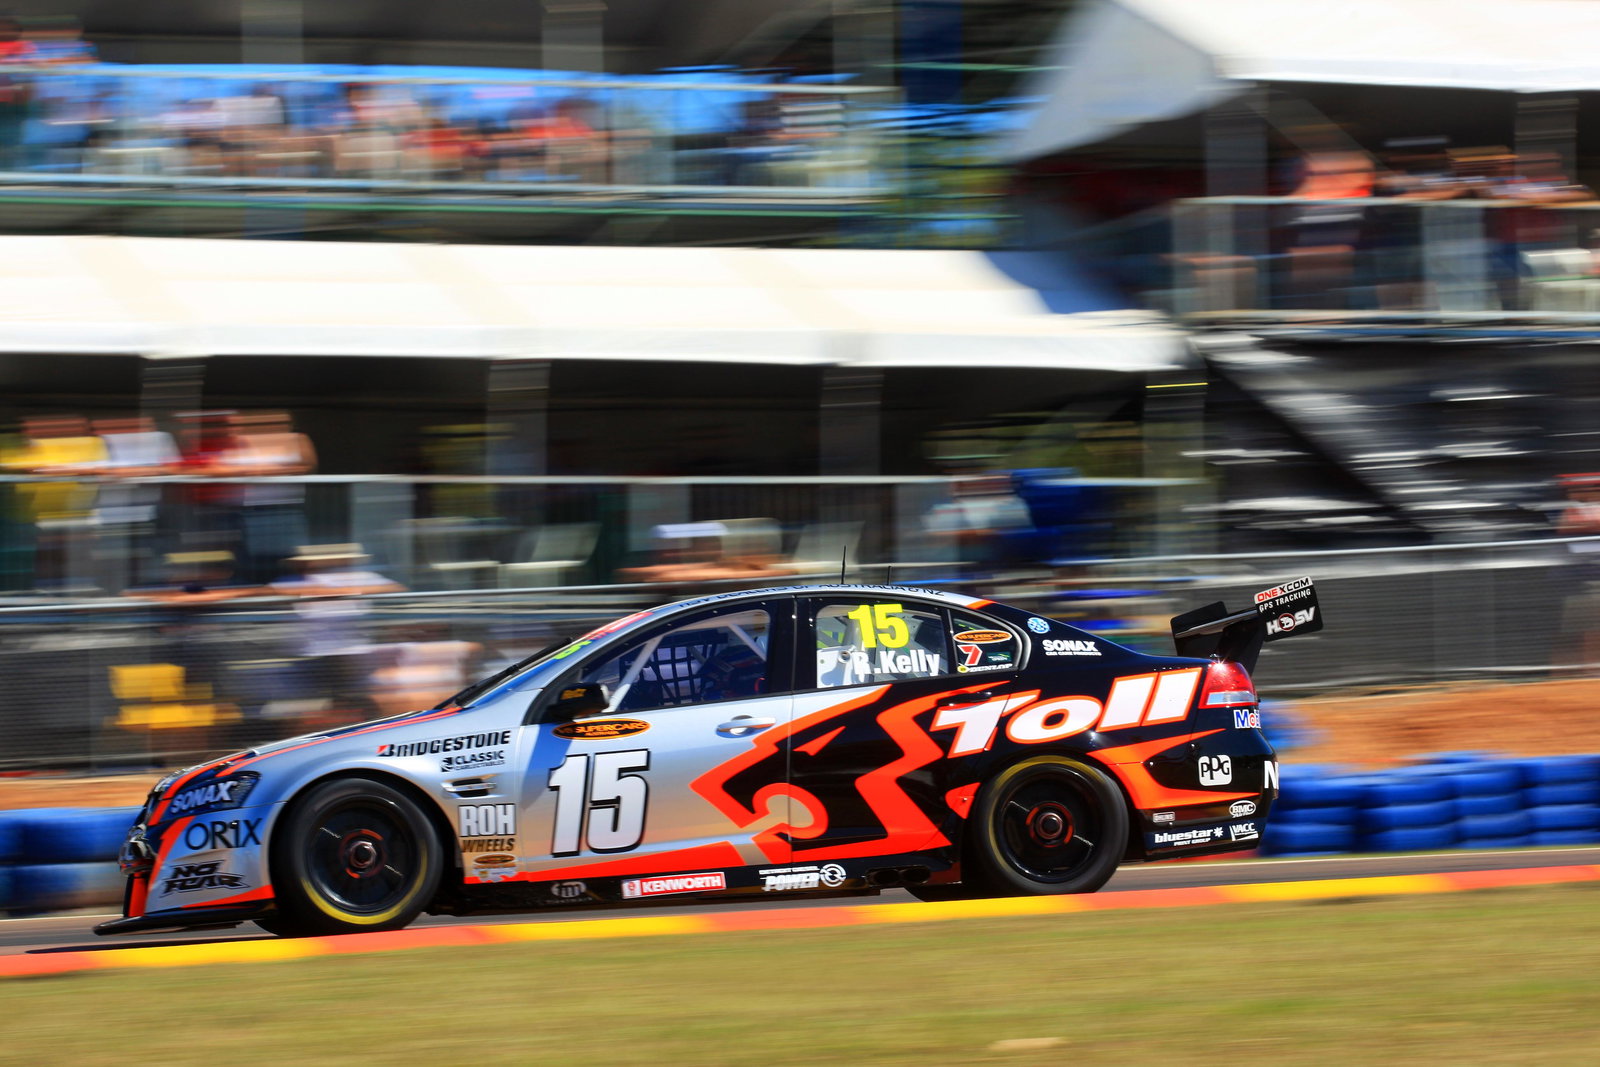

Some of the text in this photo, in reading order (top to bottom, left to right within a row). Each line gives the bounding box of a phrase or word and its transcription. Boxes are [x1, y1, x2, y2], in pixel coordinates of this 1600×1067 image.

[922, 588, 945, 597] NZ
[1258, 588, 1311, 613] GPS TRACKING
[847, 603, 910, 649] 15
[1042, 639, 1099, 652] SONAX
[930, 667, 1202, 758] Toll
[575, 722, 648, 733] SUPERCARS
[376, 730, 511, 757] BRIDGESTONE
[455, 750, 505, 765] CLASSIC
[170, 781, 238, 813] SONAX
[547, 748, 651, 858] 15
[1232, 804, 1254, 813] BMC
[459, 803, 517, 837] ROH
[1232, 823, 1256, 833] VACC
[1155, 829, 1213, 843] bluestar
[462, 838, 515, 852] WHEELS
[642, 876, 722, 893] KENWORTH
